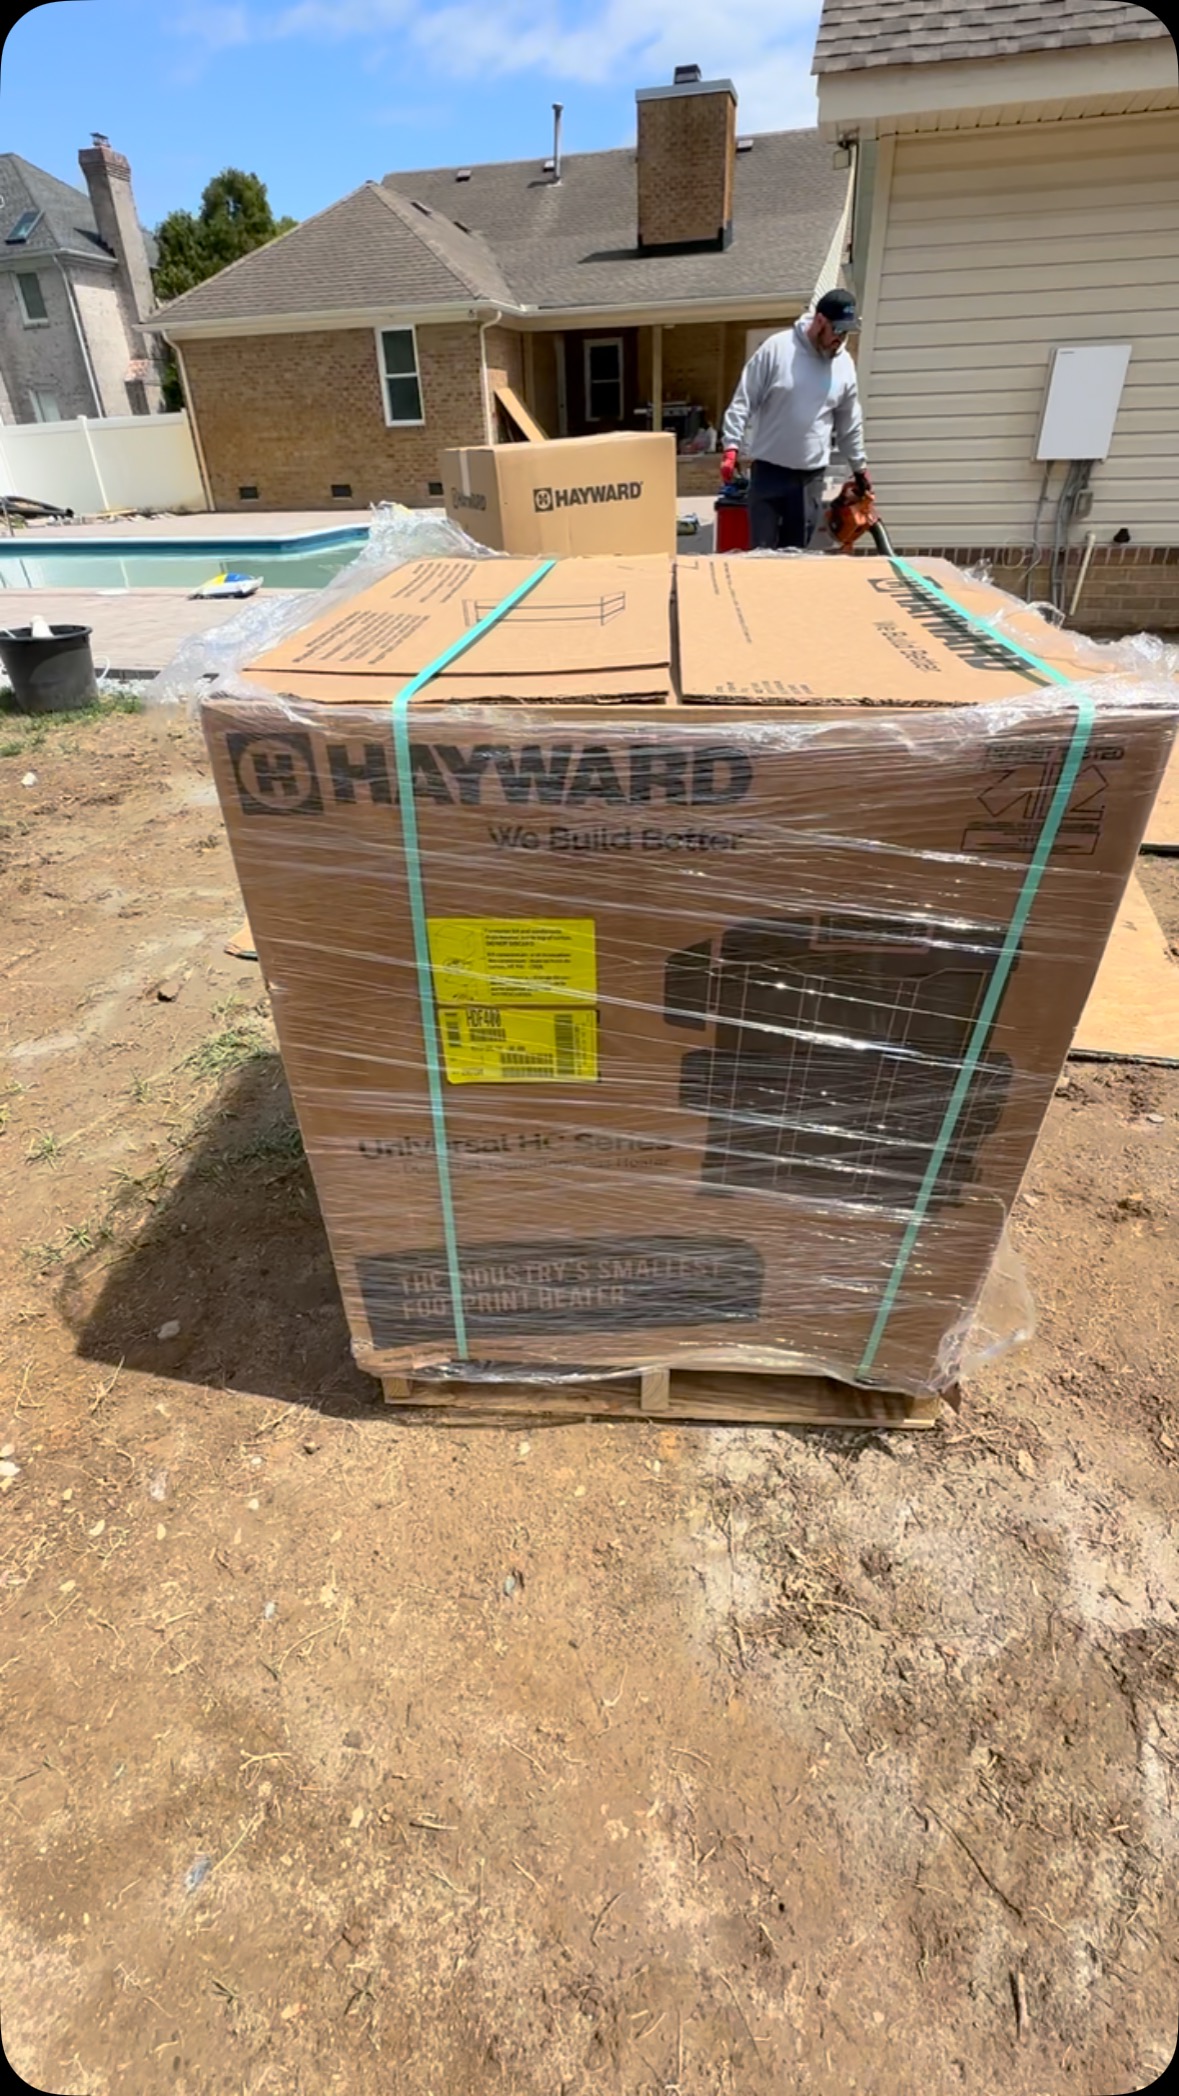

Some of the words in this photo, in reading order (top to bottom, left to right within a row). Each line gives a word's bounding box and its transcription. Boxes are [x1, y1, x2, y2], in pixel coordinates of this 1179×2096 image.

[555, 481, 643, 508] HAYWARD
[326, 743, 754, 806] HAYWARD
[488, 826, 540, 849] We
[549, 825, 632, 851] Build
[641, 827, 743, 851] Better
[359, 1132, 512, 1159] Univrsal
[402, 1289, 530, 1320] FOOPRINT
[539, 1285, 624, 1310] HEATER
